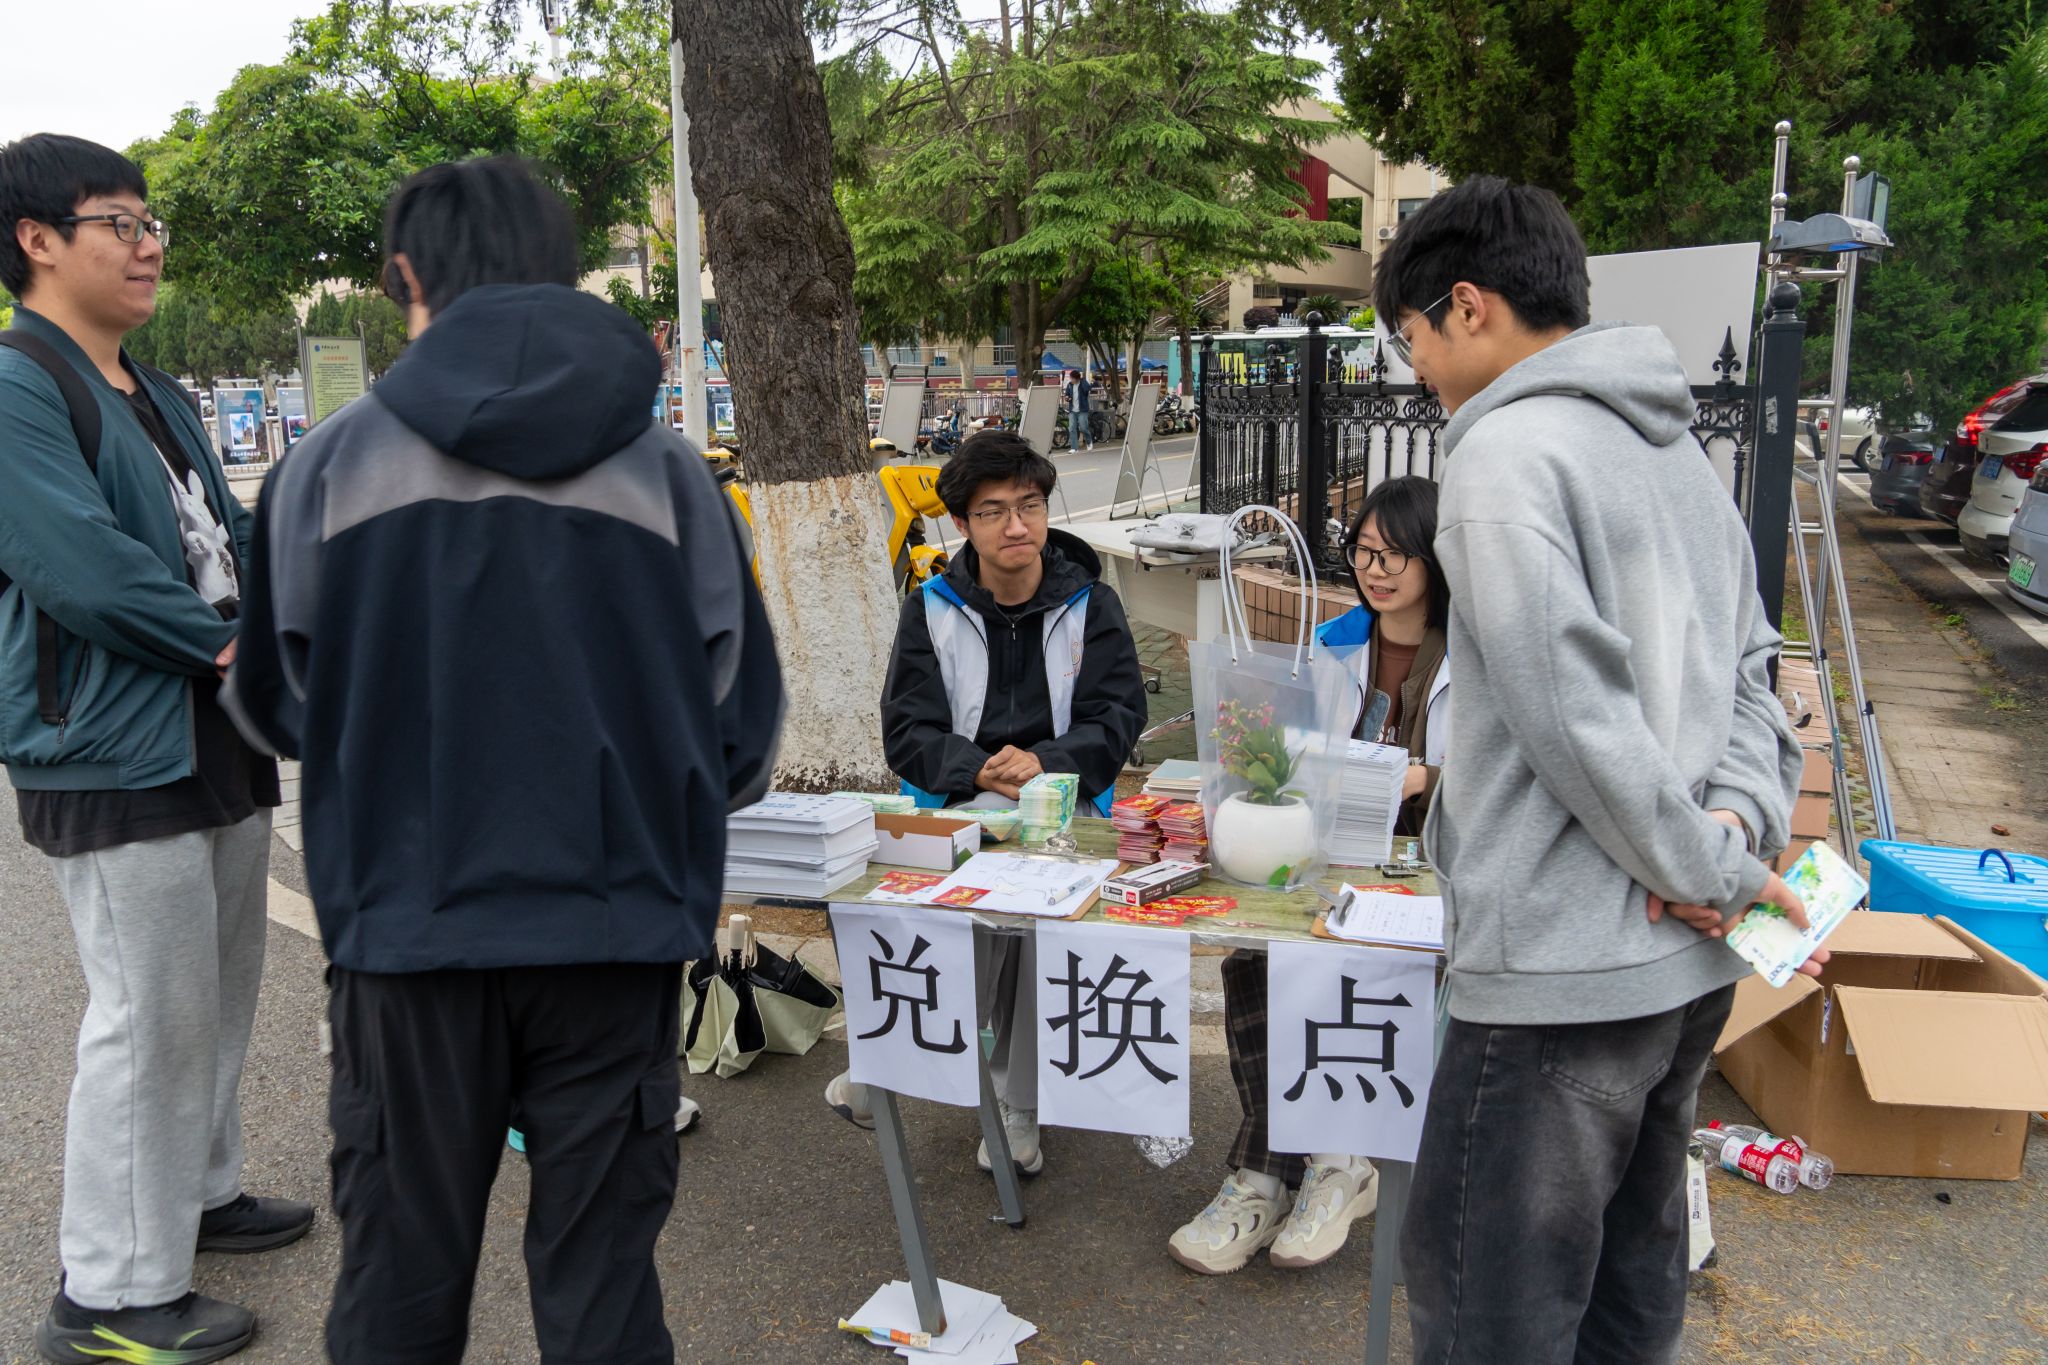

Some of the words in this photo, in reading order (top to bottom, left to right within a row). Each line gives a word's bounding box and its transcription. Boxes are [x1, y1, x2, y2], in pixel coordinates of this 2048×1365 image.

[856, 929, 968, 1055] 兑
[1045, 949, 1179, 1085] 换
[1283, 974, 1415, 1109] 点
[1768, 961, 1788, 982] TICKET
